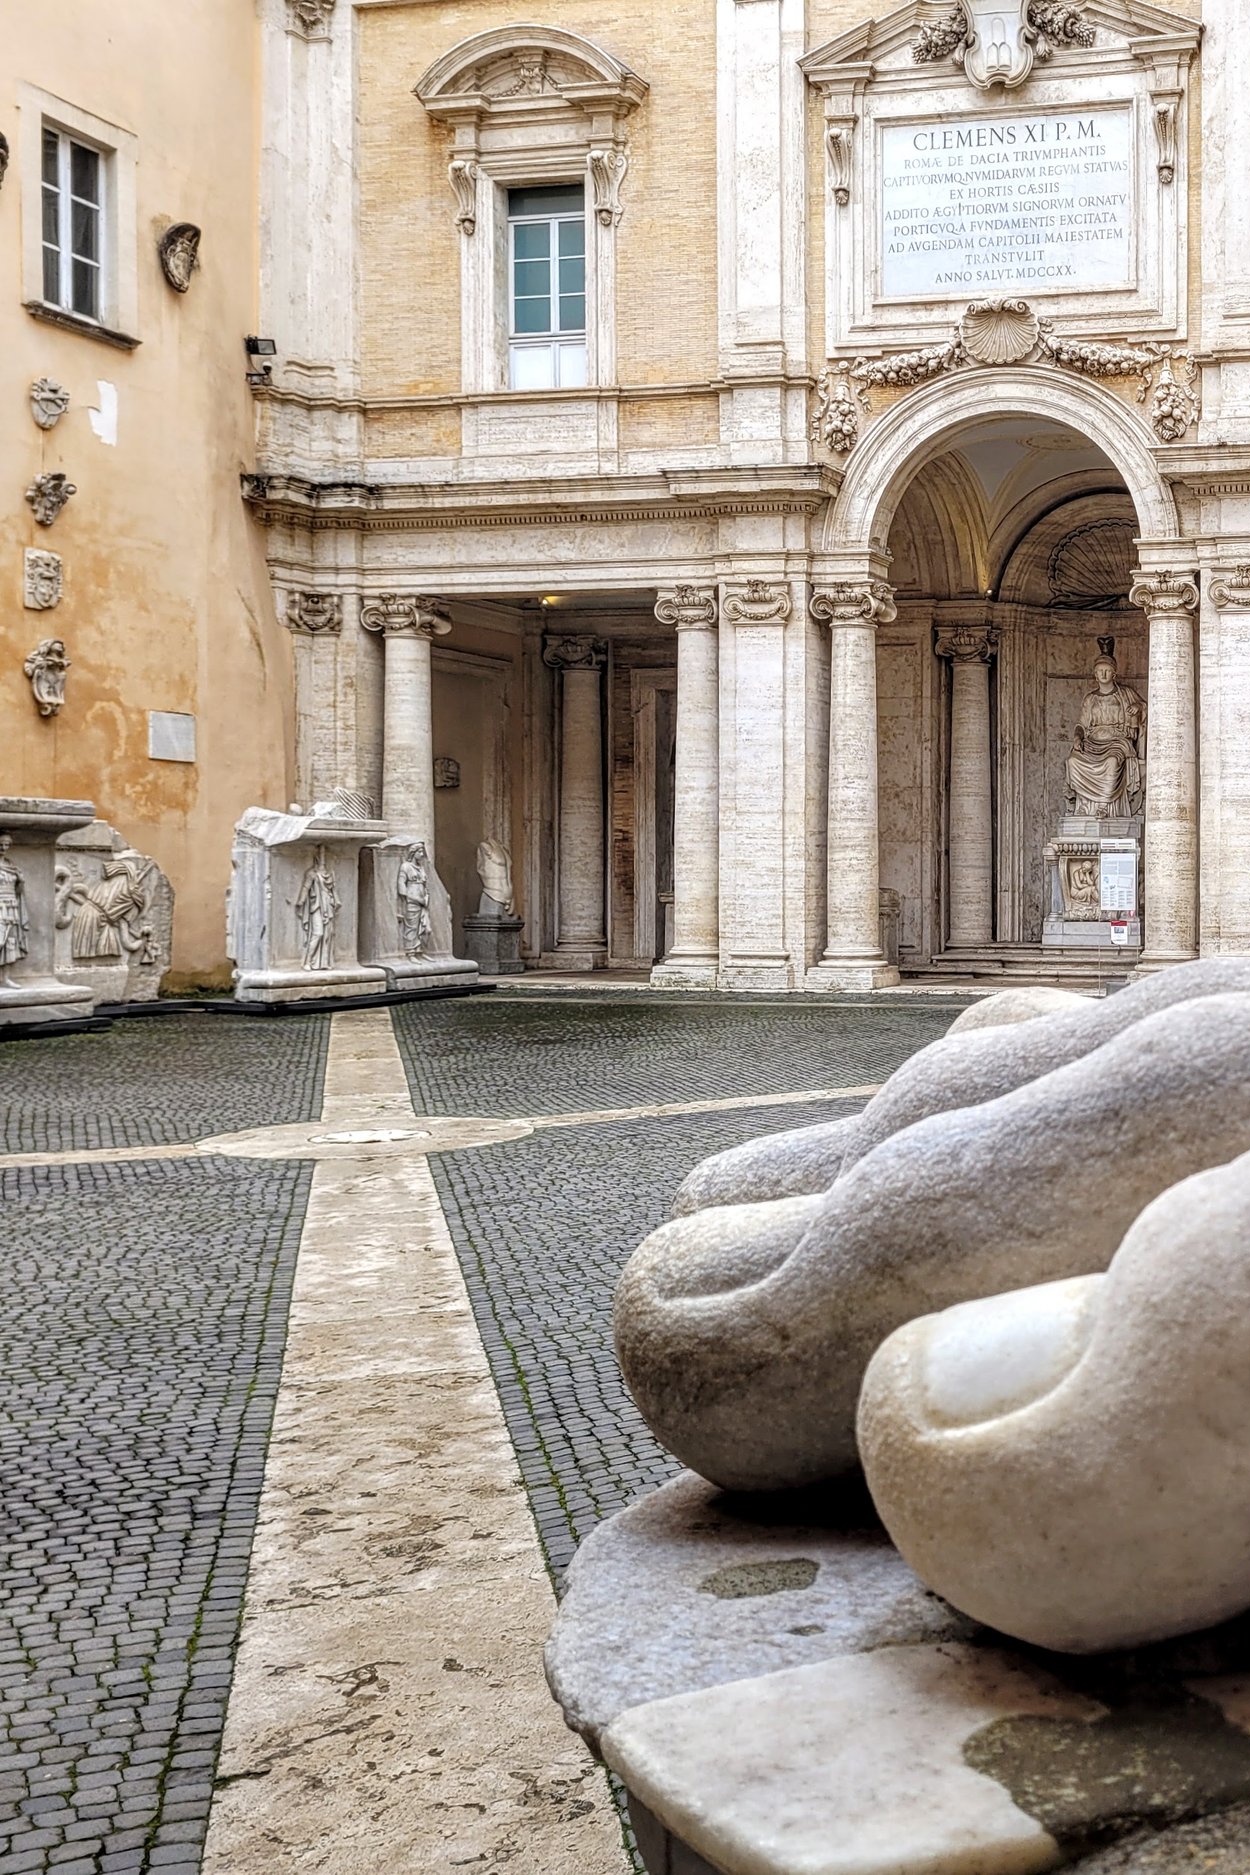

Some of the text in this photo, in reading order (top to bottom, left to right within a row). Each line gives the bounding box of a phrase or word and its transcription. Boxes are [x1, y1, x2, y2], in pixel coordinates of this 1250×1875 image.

[913, 119, 1101, 151] CLEMENS XI P. M.
[904, 145, 1106, 169] ROMÆ DE DACIA TRIVMPHANTIS
[1039, 164, 1080, 177] REGVM
[1083, 160, 1128, 174] STATVAS
[950, 189, 964, 200] EX
[968, 185, 1013, 198] HORTIS
[885, 208, 930, 221] ADDITO
[1012, 198, 1075, 212] SIGNORVM
[1078, 194, 1127, 208] ORNATV
[970, 215, 1056, 232] FVNDAMENTIS
[1060, 212, 1117, 226] EXCITATA
[888, 228, 1123, 254] AD AVGENDAM CAPITOLII MAIESTATEM
[965, 250, 1045, 265] TRANSTVLIT
[935, 271, 972, 284] ANNO
